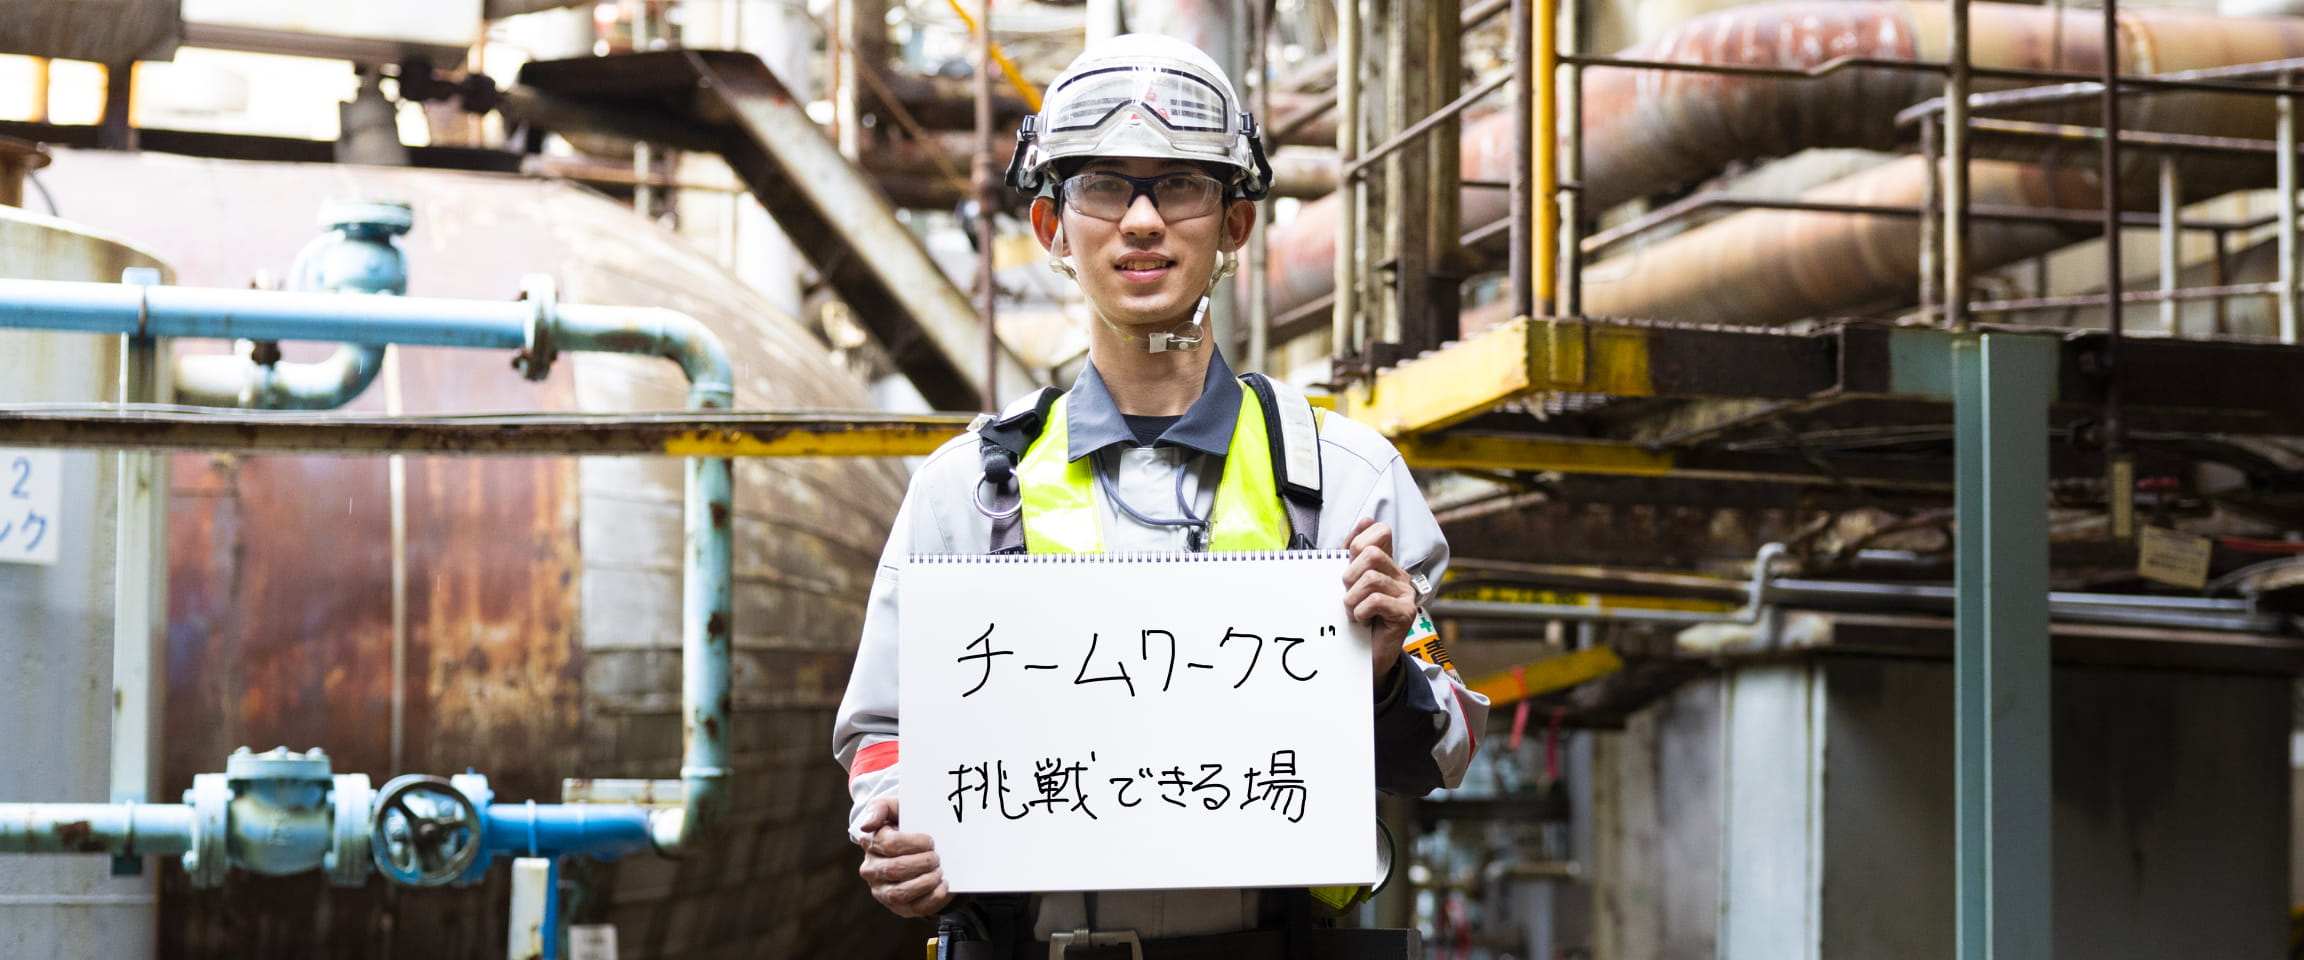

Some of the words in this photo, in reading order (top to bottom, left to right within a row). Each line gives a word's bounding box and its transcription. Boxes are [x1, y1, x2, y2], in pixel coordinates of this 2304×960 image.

[11, 457, 31, 499] 2
[957, 622, 1336, 698] チームワークで
[947, 749, 1307, 824] 挑戦できる場
